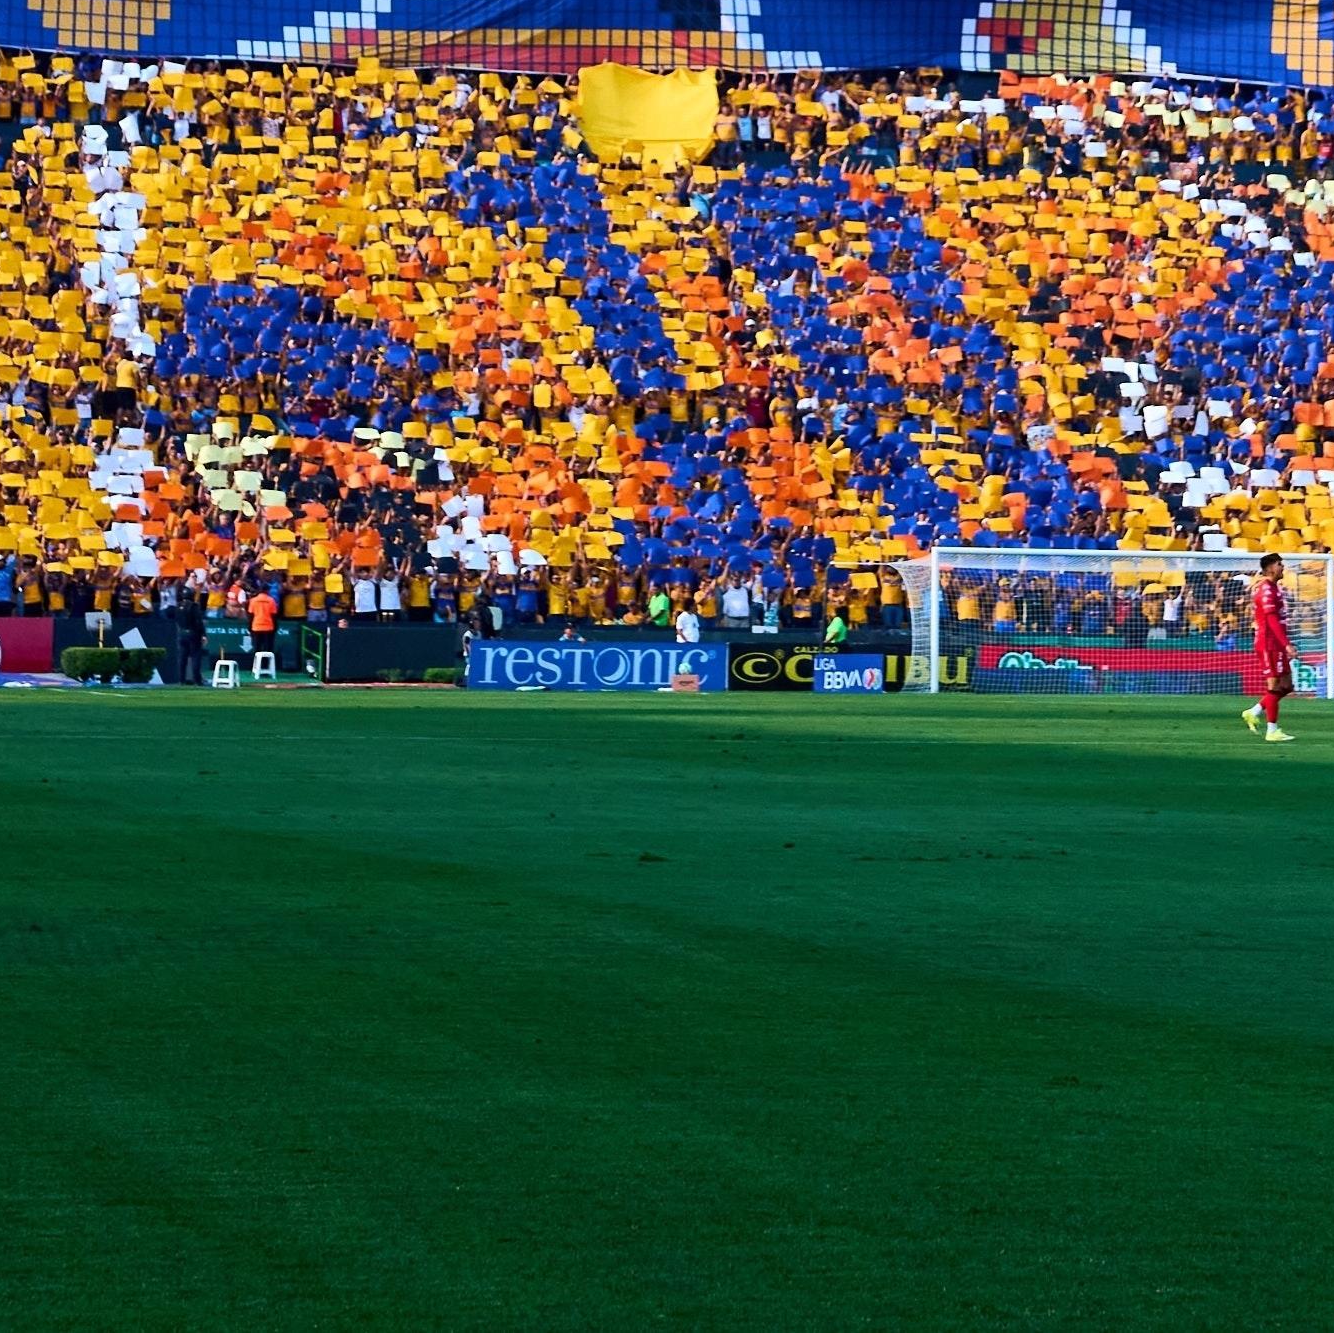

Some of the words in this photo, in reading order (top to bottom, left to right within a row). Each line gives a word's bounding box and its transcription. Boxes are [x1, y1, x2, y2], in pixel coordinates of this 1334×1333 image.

[794, 646, 839, 654] CALZDO
[813, 657, 837, 671] LIGA
[823, 669, 863, 689] BBVA
